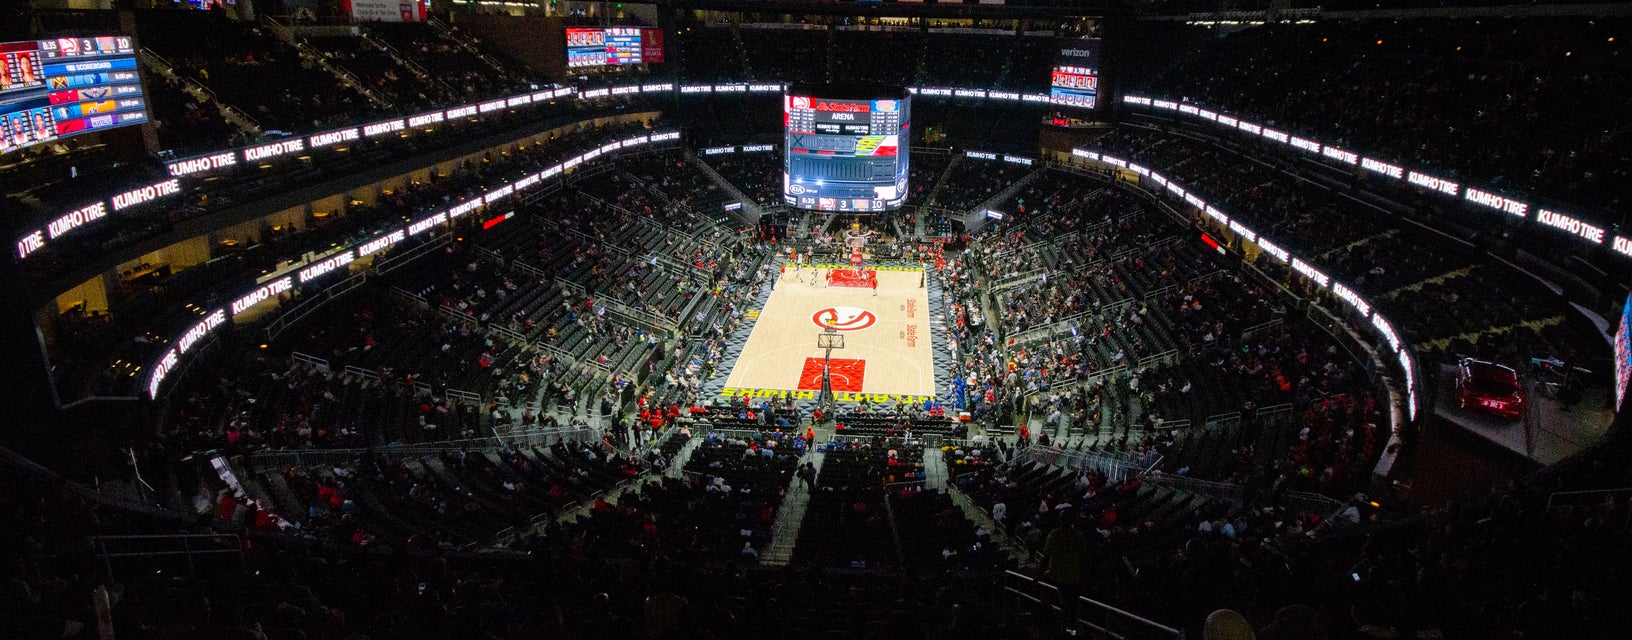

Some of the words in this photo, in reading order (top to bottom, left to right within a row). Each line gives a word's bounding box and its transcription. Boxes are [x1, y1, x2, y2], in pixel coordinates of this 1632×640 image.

[42, 41, 57, 50] 8:35
[83, 40, 92, 51] 3
[117, 38, 129, 49] 10
[1061, 48, 1090, 57] verizon
[642, 84, 661, 92] KUMHO
[447, 108, 465, 119] KUMHO
[465, 106, 477, 116] TIRE
[829, 101, 849, 112] State
[849, 103, 870, 113] Farm
[364, 122, 391, 136] KUMHO
[389, 120, 404, 131] TIRE
[408, 114, 430, 127] KUMHO
[430, 112, 444, 123] TIRE
[310, 131, 341, 147] KUMHO
[340, 128, 358, 142] TIRE
[1290, 136, 1309, 150] KUMHO
[1308, 141, 1320, 153] TIRE
[209, 152, 235, 169] TIRE
[244, 142, 283, 161] KUMHO
[281, 139, 303, 154] TIRE
[1323, 146, 1345, 161] KUMHO
[1343, 151, 1358, 164] TIRE
[1362, 158, 1387, 174] KUMHO
[1385, 163, 1402, 179] TIRE
[791, 186, 804, 194] KIA
[1408, 171, 1440, 191] KUMHO
[1438, 180, 1458, 195] TIRE
[112, 186, 156, 210] KUMHO
[154, 179, 179, 197] TIRE
[485, 188, 503, 204] KUMHO
[502, 185, 513, 197] TIRE
[841, 200, 847, 209] 3
[872, 200, 882, 209] 10
[1466, 188, 1504, 209] KUMHO
[1502, 199, 1527, 217] TIRE
[450, 202, 470, 218] KUMHO
[469, 197, 482, 211] TIRE
[49, 211, 83, 239] KUMHO
[80, 202, 106, 225] TIRE
[408, 217, 433, 235] KUMHO
[431, 212, 446, 227] TIRE
[1537, 209, 1581, 234] KUMHO
[1579, 222, 1604, 243] TIRE
[23, 230, 44, 254] TIRE
[359, 235, 389, 257] KUMHO
[387, 229, 404, 246] TIRE
[1258, 237, 1278, 257] KUMHO
[1276, 246, 1289, 262] TIRE
[299, 257, 335, 283] KUMHO
[333, 251, 354, 269] TIRE
[1291, 258, 1315, 280] KUMHO
[1313, 268, 1329, 287] TIRE
[231, 287, 269, 314] KUMHO
[267, 276, 292, 298] TIRE
[1333, 282, 1358, 308] KUMHO
[1356, 295, 1370, 317] TIRE
[179, 322, 206, 354] KUMHO
[204, 309, 225, 334] TIRE
